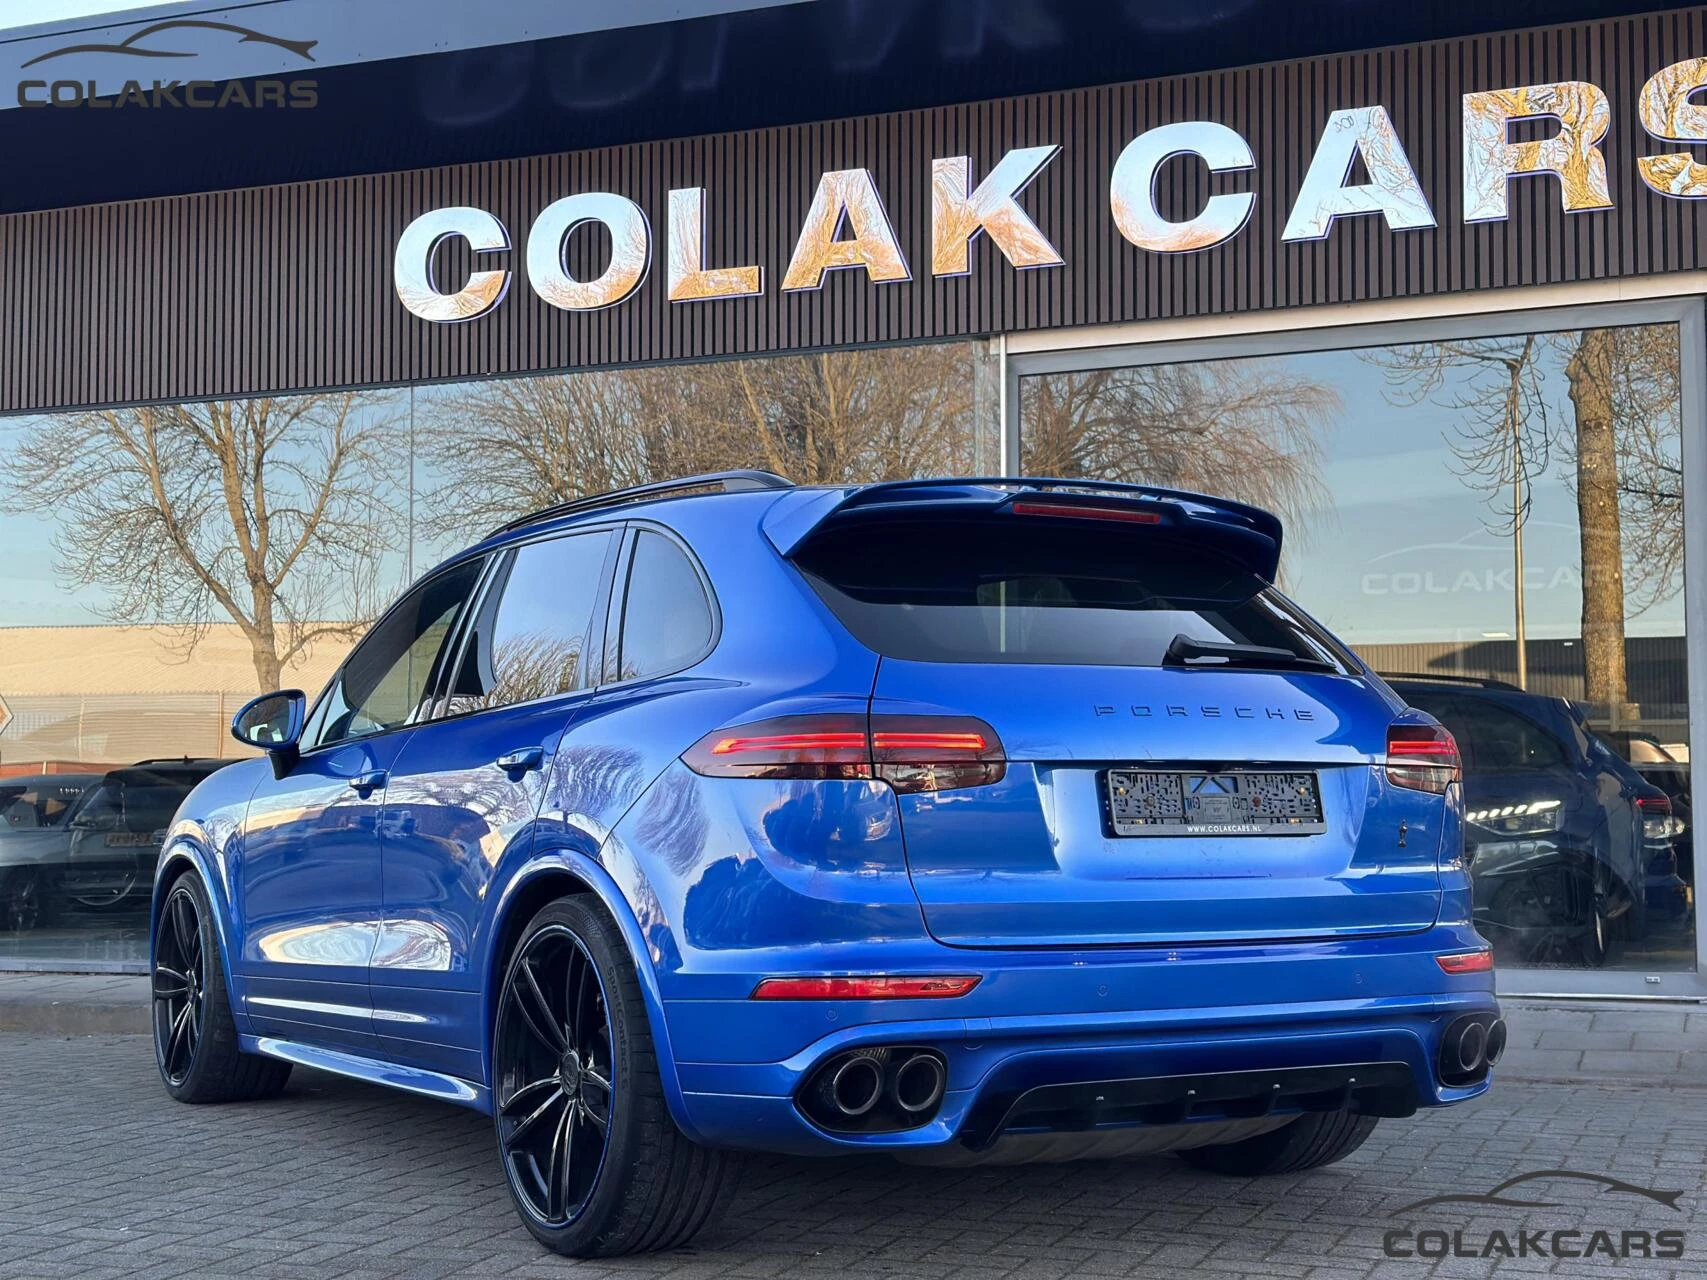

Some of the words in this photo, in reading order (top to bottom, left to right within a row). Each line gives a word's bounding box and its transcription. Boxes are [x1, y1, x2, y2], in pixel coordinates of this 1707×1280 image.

[393, 144, 1065, 325] COLAK
[1109, 56, 1707, 255] CARS
[1095, 705, 1316, 721] PORSCHE
[1186, 824, 1263, 835] WWW.COLAKCARS.NL
[606, 965, 629, 1073] SportContact
